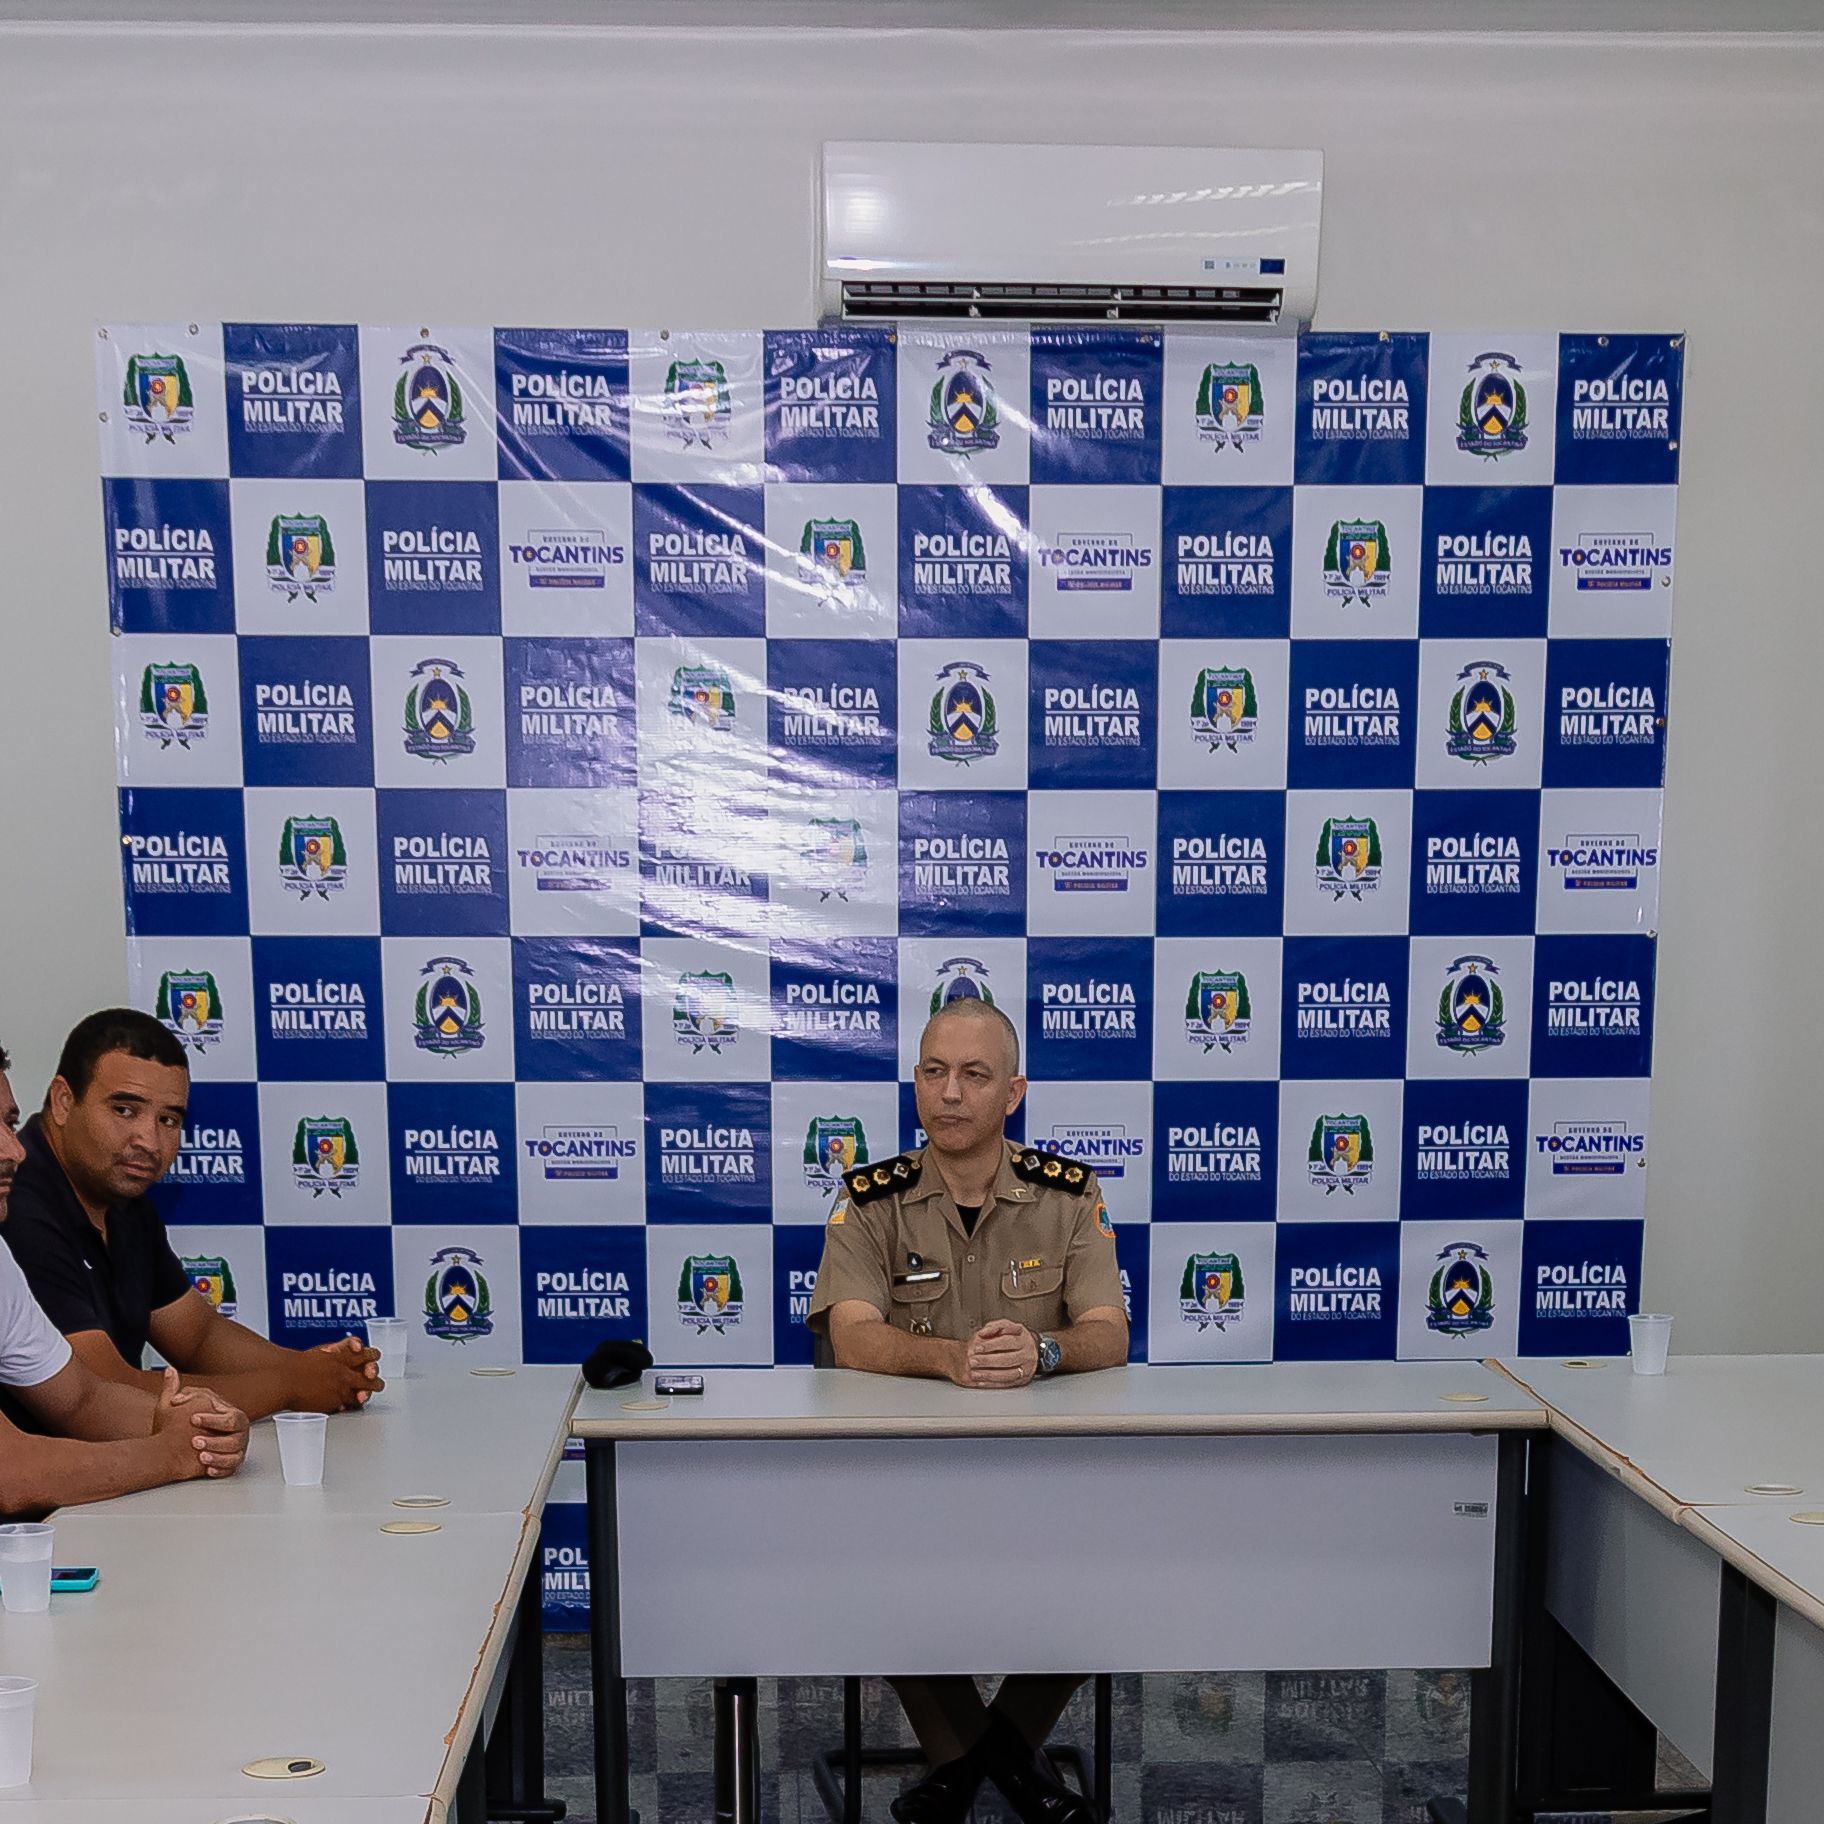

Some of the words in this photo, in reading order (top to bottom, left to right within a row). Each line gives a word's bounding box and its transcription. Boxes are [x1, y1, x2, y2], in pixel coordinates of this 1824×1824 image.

[241, 366, 341, 393] POLÍCIA
[513, 369, 611, 397] POLÍCIA
[780, 372, 878, 399] POLÍCIA
[1047, 374, 1144, 401] POLÍCIA
[1313, 374, 1409, 401] POLÍCIA
[1574, 374, 1670, 401] POLÍCIA
[243, 401, 343, 423] MILITAR
[514, 404, 613, 426] MILITAR
[781, 406, 878, 428] MILITAR
[1047, 408, 1144, 430] MILITAR
[1312, 408, 1409, 430] MILITAR
[1572, 408, 1669, 430] MILITAR
[114, 523, 213, 550] POLÍCIA
[383, 526, 481, 552] POLÍCIA
[649, 528, 746, 555] POLÍCIA
[914, 530, 1010, 556] POLÍCIA
[1178, 530, 1274, 556] POLÍCIA
[1437, 530, 1533, 557] POLÍCIA
[509, 546, 624, 564] TOCANTINS
[1038, 548, 1151, 567] TOCANTINS
[1559, 548, 1671, 566] TOCANTINS
[116, 557, 216, 579] MILITAR
[384, 559, 483, 581] MILITAR
[650, 562, 747, 584] MILITAR
[914, 563, 1011, 585] MILITAR
[1177, 564, 1274, 585] MILITAR
[1436, 564, 1532, 585] MILITAR
[255, 680, 353, 706] POLÍCIA
[520, 681, 617, 707] POLÍCIA
[1045, 683, 1139, 709] POLÍCIA
[1305, 683, 1400, 708] POLÍCIA
[1561, 682, 1656, 707] POLÍCIA
[257, 713, 355, 734] MILITAR
[521, 714, 618, 735] MILITAR
[1044, 716, 1140, 737] MILITAR
[1304, 716, 1399, 736] MILITAR
[1560, 715, 1655, 735] MILITAR
[130, 831, 227, 856] POLÍCIA
[393, 832, 489, 857] POLÍCIA
[915, 834, 1008, 859] POLÍCIA
[1173, 833, 1267, 858] POLÍCIA
[1427, 832, 1521, 857] POLÍCIA
[517, 850, 630, 867] TOCANTINS
[1036, 851, 1147, 868] TOCANTINS
[1546, 849, 1657, 866] TOCANTINS
[132, 864, 230, 884] MILITAR
[395, 865, 491, 885] MILITAR
[655, 865, 751, 885] MILITAR
[915, 866, 1009, 886] MILITAR
[1172, 865, 1267, 885] MILITAR
[1426, 864, 1520, 884] MILITAR
[269, 979, 365, 1003] POLÍCIA
[528, 979, 623, 1004] POLÍCIA
[787, 979, 880, 1003] POLÍCIA
[1043, 979, 1136, 1003] POLÍCIA
[1298, 978, 1390, 1002] POLÍCIA
[1549, 976, 1641, 1000] POLÍCIA
[270, 1010, 366, 1030] MILITAR
[529, 1011, 624, 1031] MILITAR
[1043, 1010, 1136, 1030] MILITAR
[1297, 1009, 1390, 1029] MILITAR
[1548, 1008, 1640, 1027] MILITAR
[180, 1124, 242, 1149] LÍCIA
[404, 1125, 498, 1149] POLÍCIA
[660, 1124, 753, 1148] POLÍCIA
[1169, 1122, 1260, 1146] POLÍCIA
[1418, 1120, 1510, 1144] POLÍCIA
[525, 1140, 636, 1157] TOCANTINS
[1034, 1139, 1143, 1156] TOCANTINS
[1535, 1135, 1643, 1152] TOCANTINS
[406, 1156, 500, 1175] MILITAR
[661, 1155, 754, 1174] MILITAR
[1168, 1153, 1260, 1172] MILITAR
[1417, 1151, 1509, 1170] MILITAR
[282, 1268, 376, 1292] POLÍCIA
[537, 1267, 629, 1291] POLÍCIA
[1291, 1263, 1382, 1286] POLÍCIA
[1537, 1260, 1628, 1284] POLÍCIA
[283, 1298, 377, 1318] MILITAR
[538, 1298, 630, 1317] MILITAR
[1290, 1293, 1381, 1312] MILITAR
[1536, 1290, 1627, 1310] MILITAR
